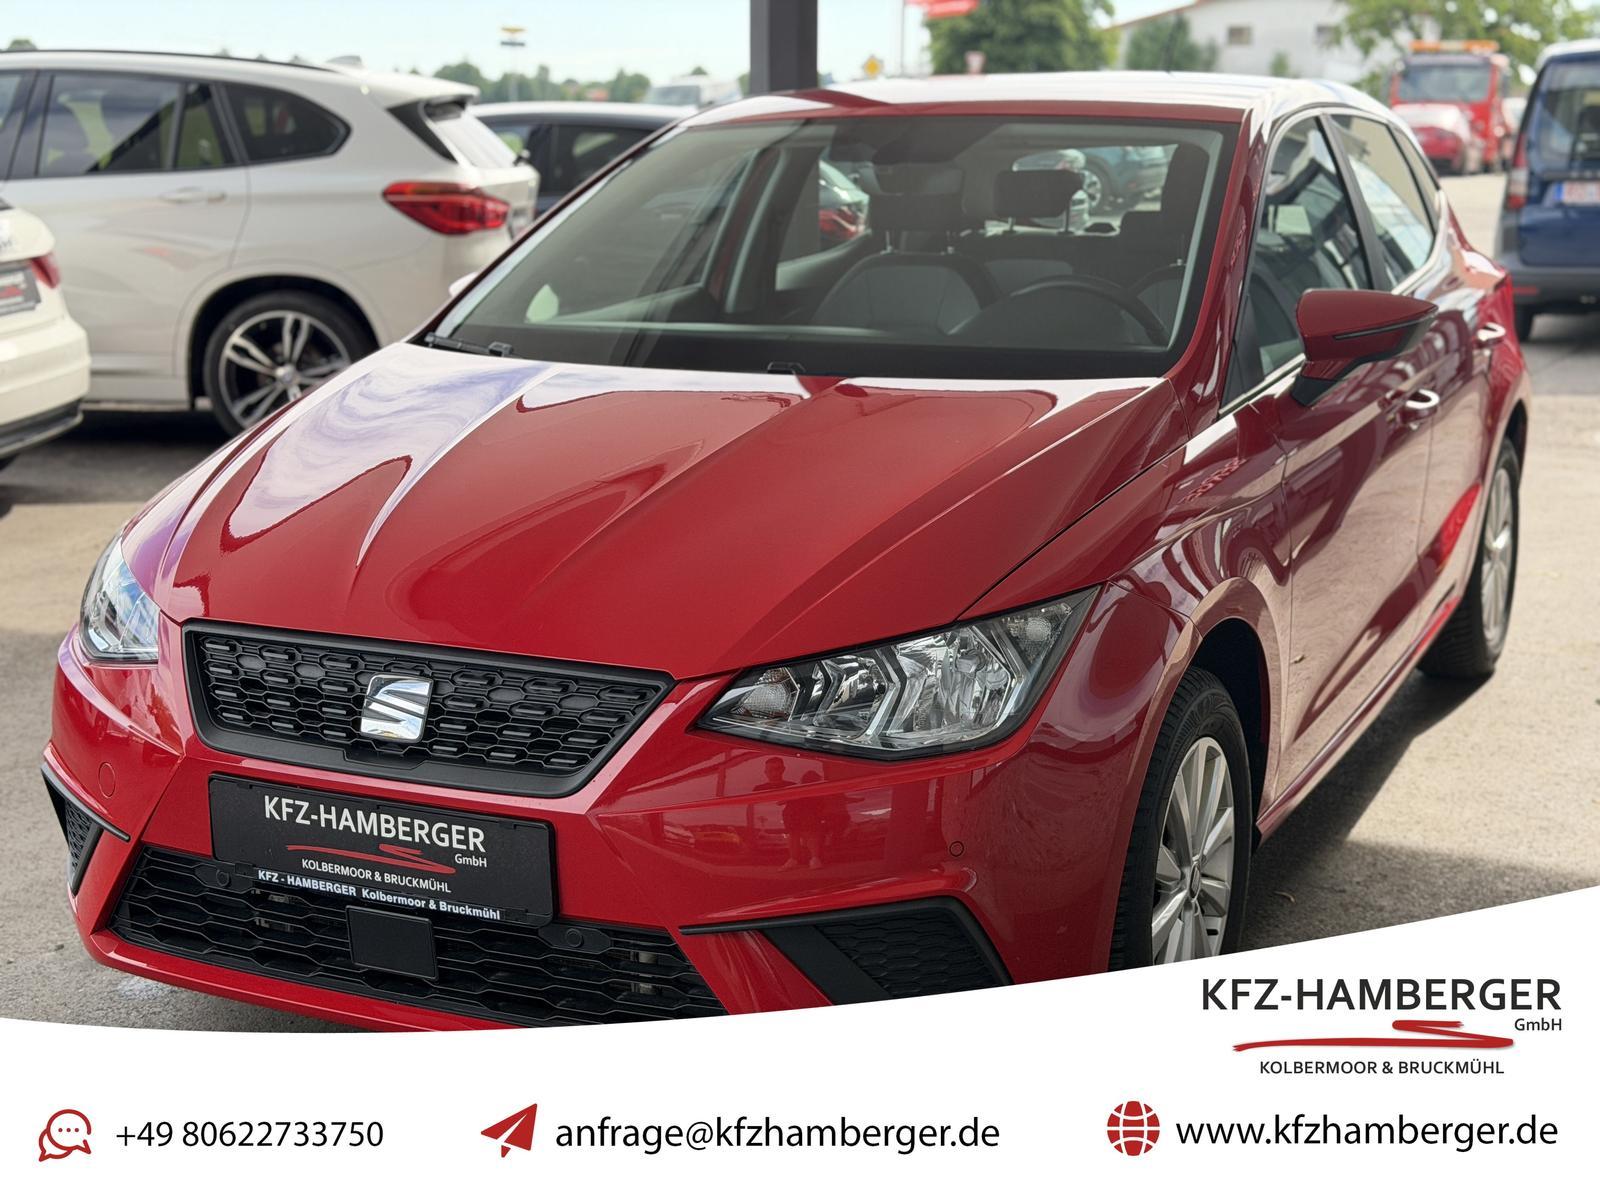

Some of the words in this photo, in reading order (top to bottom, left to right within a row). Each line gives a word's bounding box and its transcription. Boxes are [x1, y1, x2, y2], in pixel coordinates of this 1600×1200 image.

[264, 795, 486, 852] KFZ-HAMBERGER
[302, 859, 372, 881] KOLBERMOOR
[374, 871, 382, 882] &
[384, 873, 451, 893] BRUCKMÜHL
[455, 854, 488, 868] GmbH
[258, 870, 279, 883] KFZ
[287, 875, 357, 897] HAMBERGER
[362, 888, 426, 909] Kolbermoor
[428, 899, 437, 910] &
[439, 900, 501, 920] Bruckmühl
